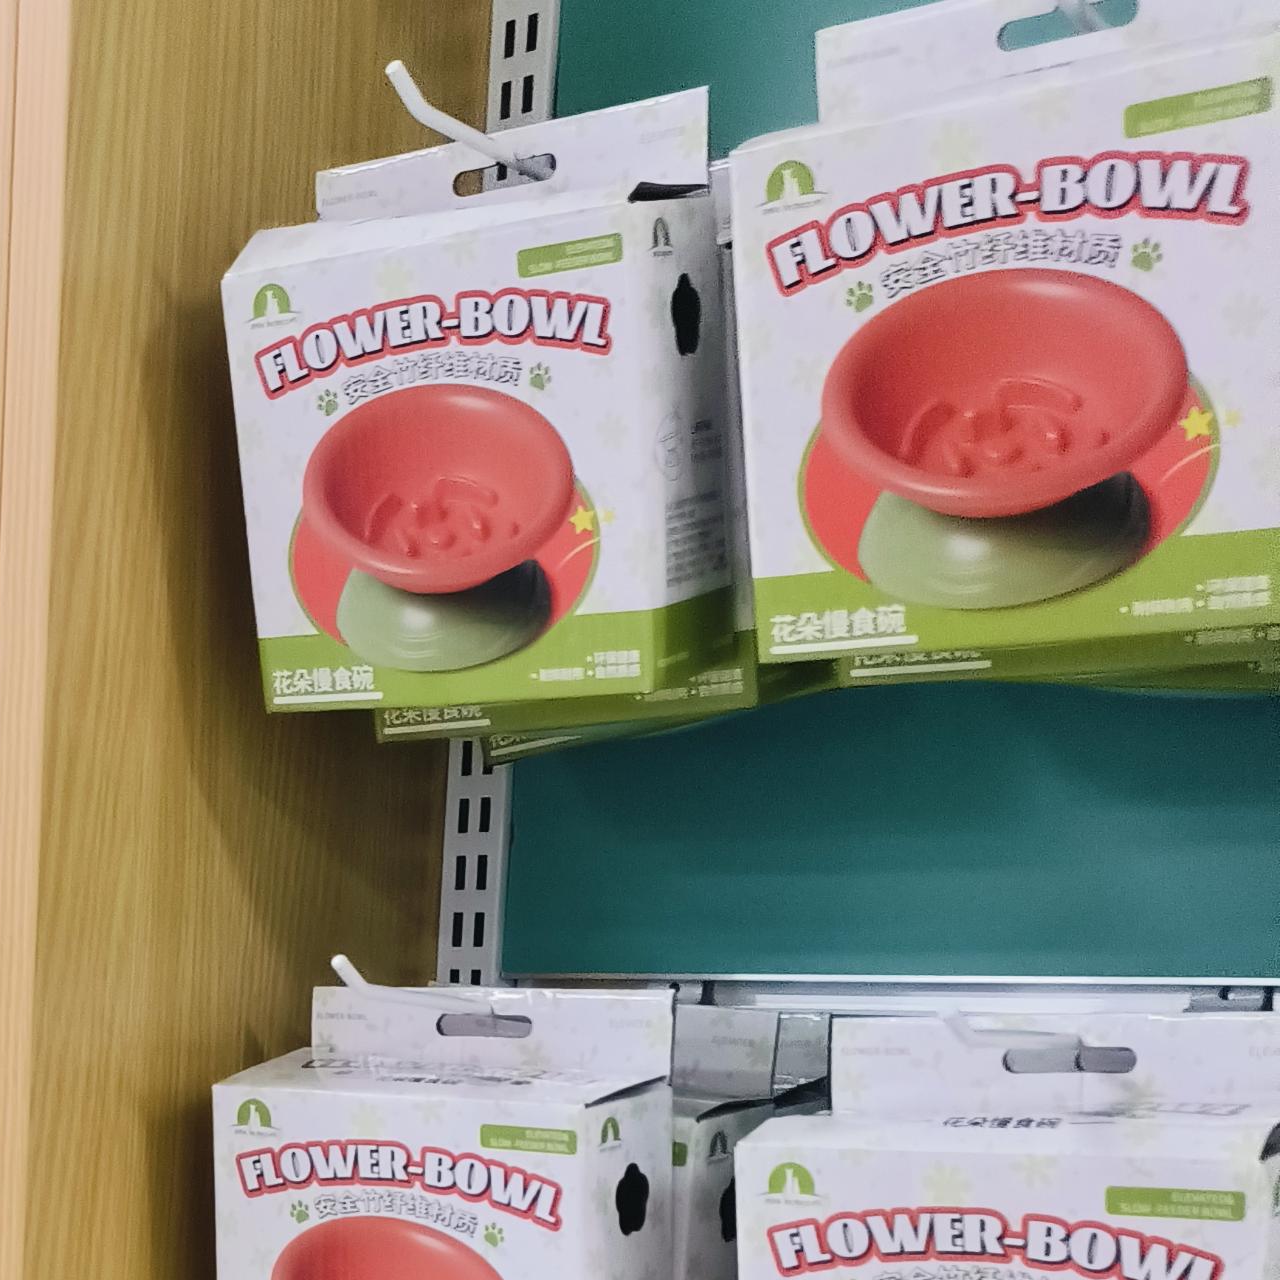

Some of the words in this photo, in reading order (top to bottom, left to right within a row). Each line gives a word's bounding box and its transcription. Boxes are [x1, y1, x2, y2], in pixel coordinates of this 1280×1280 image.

[768, 154, 1249, 293] FLOWER-BOWL
[879, 228, 1122, 299] 安全竹纤维材质
[257, 290, 611, 396] FLOWER-BOWL
[341, 350, 523, 405] 安全竹纤维材质
[769, 604, 907, 643] 花朵慢食碗
[272, 664, 375, 696] 花朵慢食碗
[237, 1141, 563, 1229] FLOWER-BOWL
[314, 1191, 480, 1238] 安全竹纤维材质
